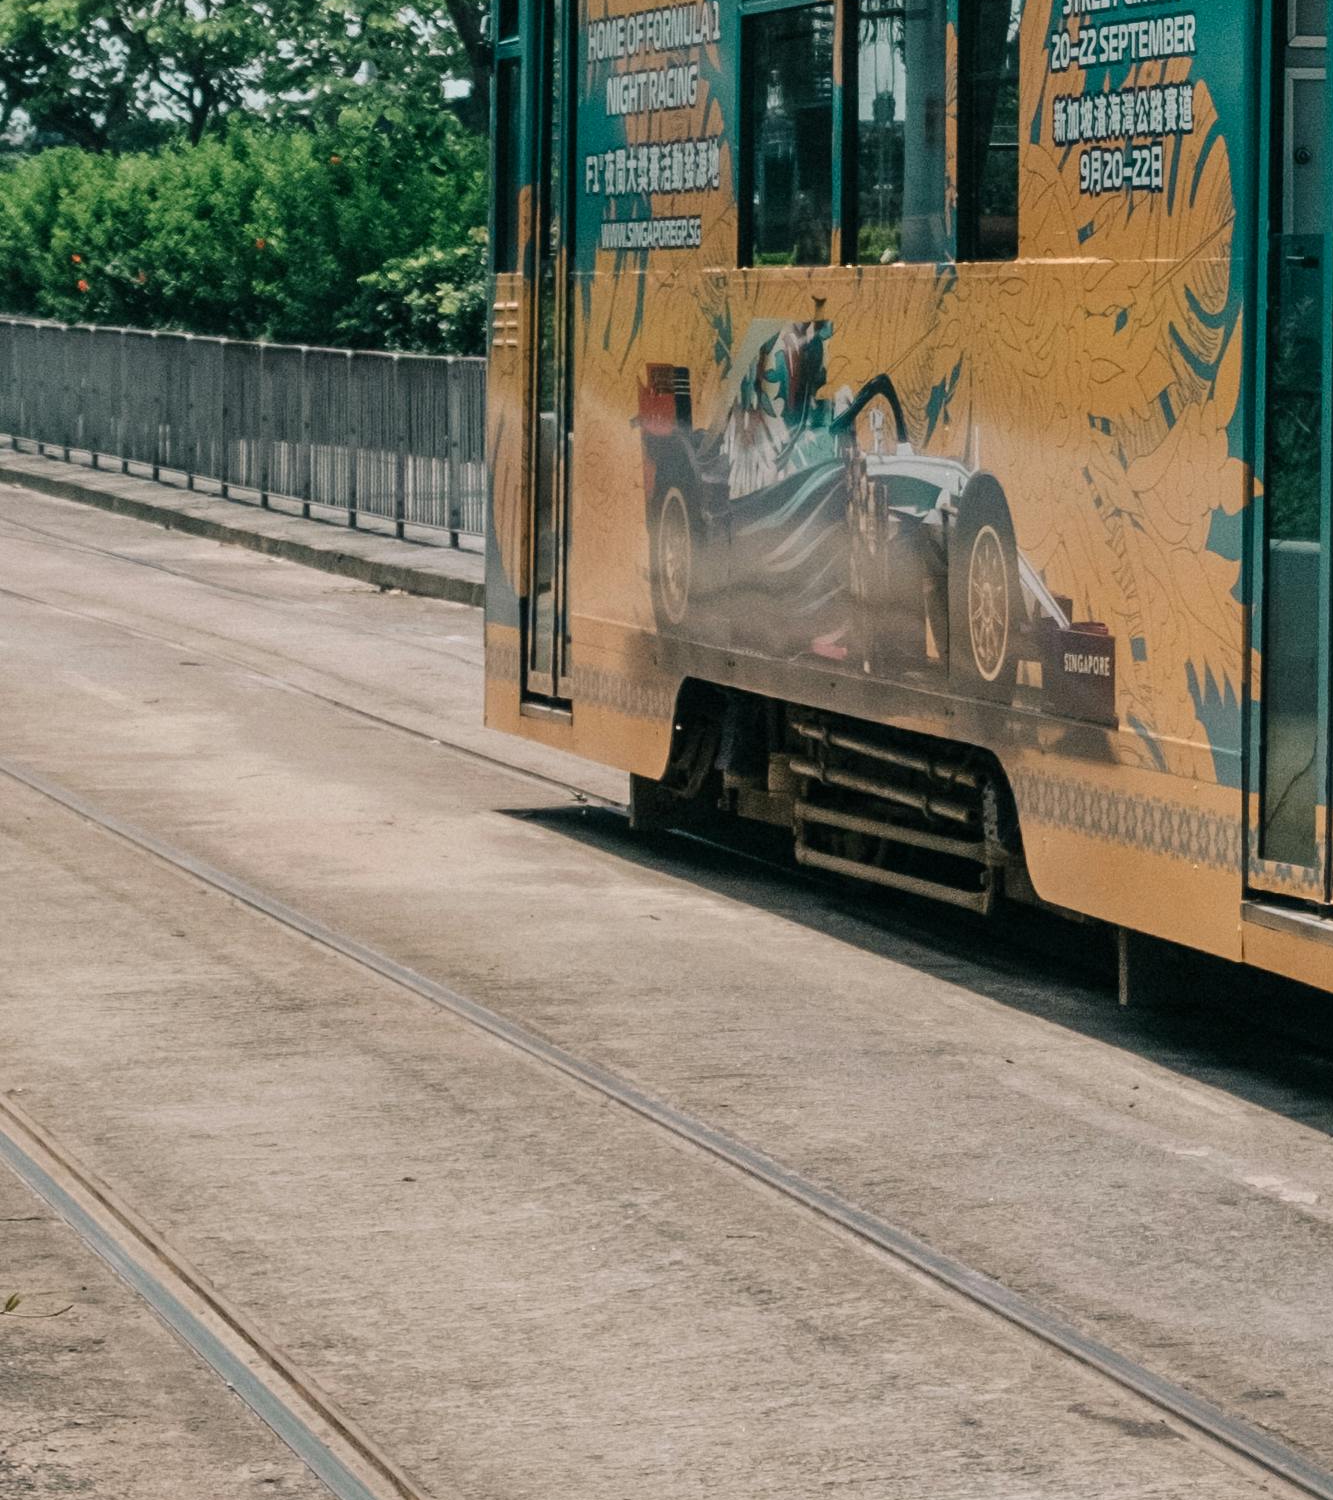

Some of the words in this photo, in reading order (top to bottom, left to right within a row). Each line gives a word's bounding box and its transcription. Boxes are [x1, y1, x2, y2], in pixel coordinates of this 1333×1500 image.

[588, 16, 625, 62] HOME
[627, 13, 645, 55] OF
[646, 2, 710, 51] FORMULA
[713, 0, 721, 41] 1
[1099, 14, 1196, 63] SEPTEMBER
[606, 73, 648, 117] NIGHT
[649, 65, 698, 109] RACING
[1053, 84, 1194, 143] 新加坡濱海灣公路賽道
[601, 220, 701, 248] WWW.SINGAPOREGP.SG
[1063, 652, 1111, 677] SINGAPORE
